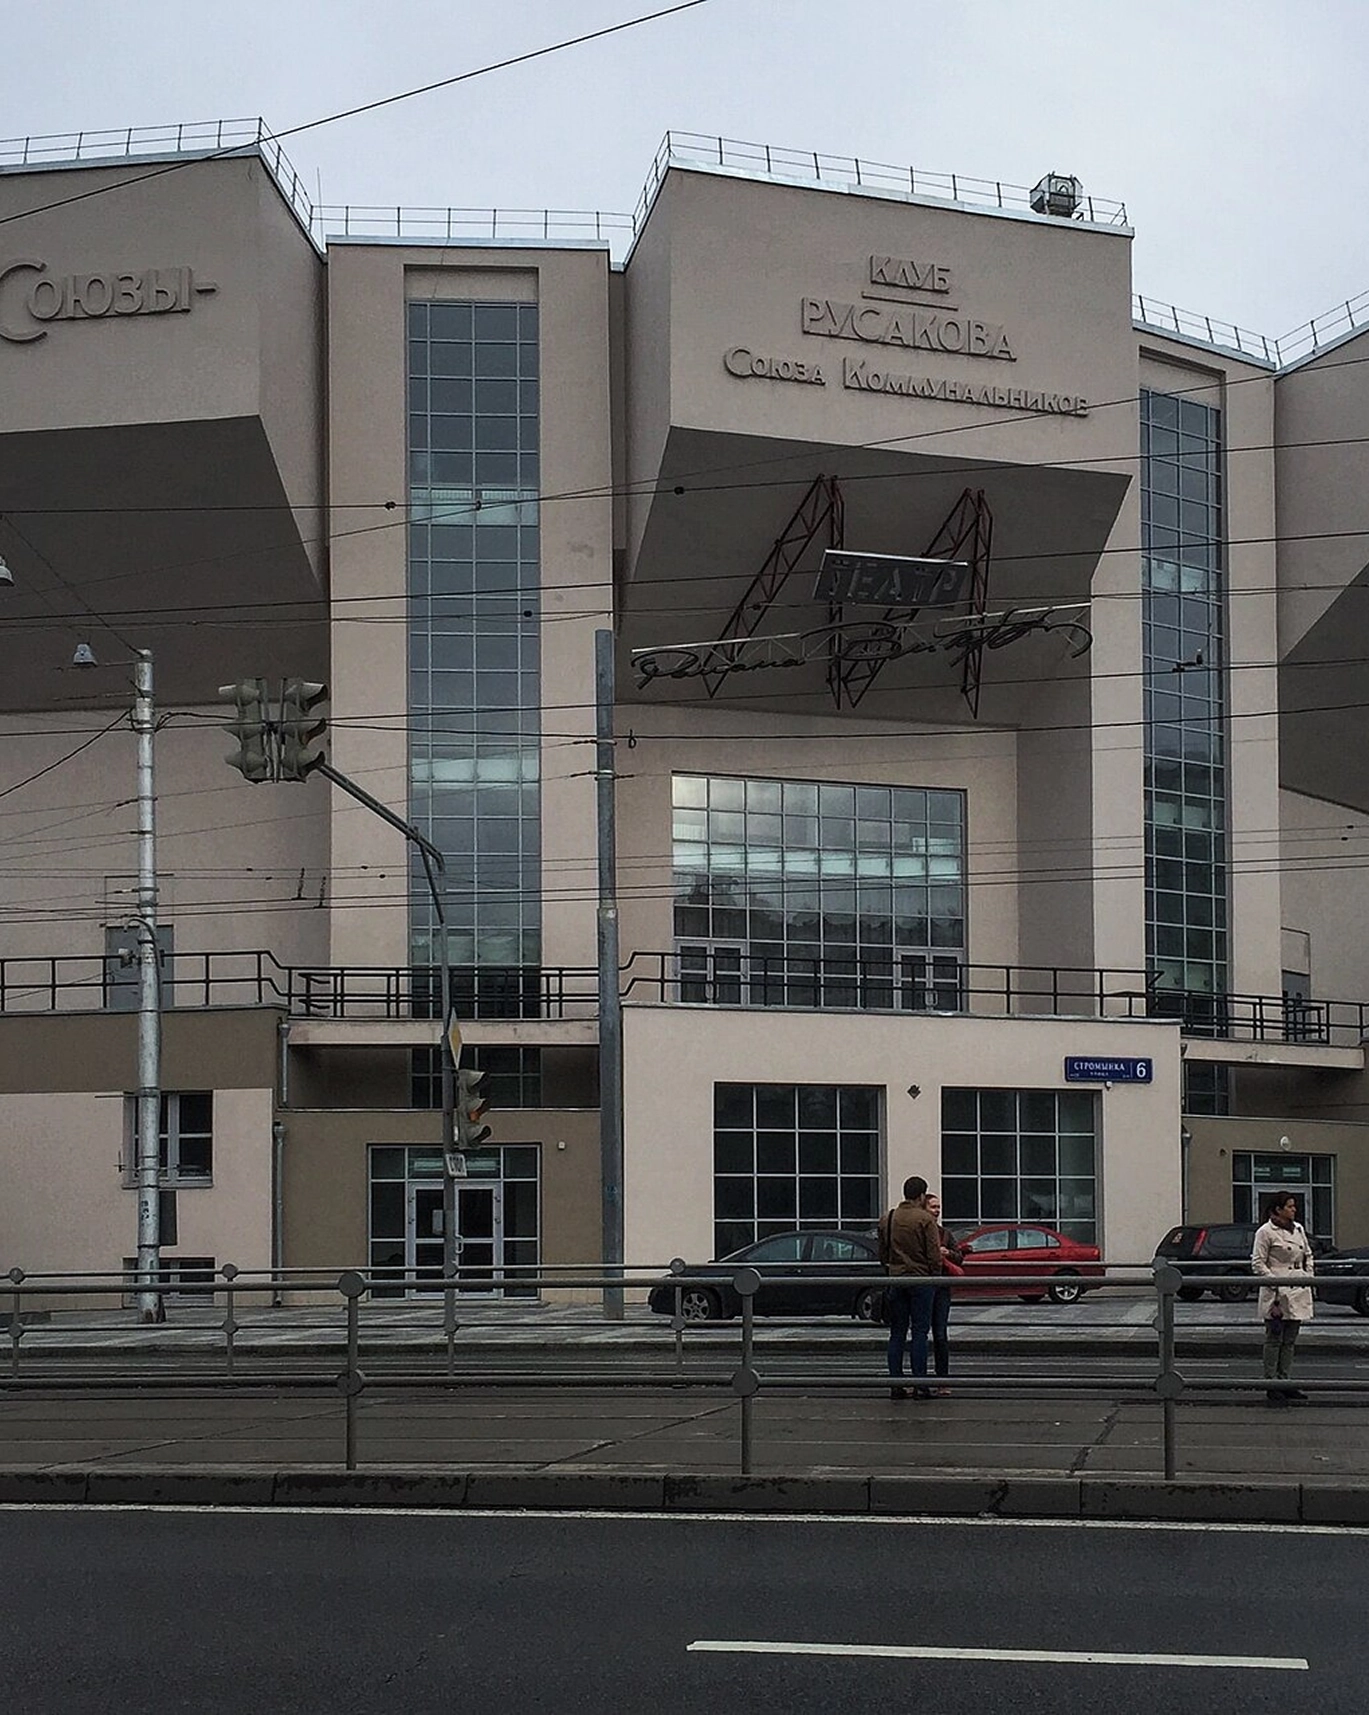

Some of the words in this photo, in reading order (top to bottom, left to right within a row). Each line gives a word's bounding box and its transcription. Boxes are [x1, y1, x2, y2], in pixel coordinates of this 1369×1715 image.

[868, 254, 951, 294] КЛУБ
[801, 297, 1018, 362] РУСАКОВА
[1073, 1061, 1126, 1071] СТРОМЫНКА
[1136, 1061, 1147, 1078] 6
